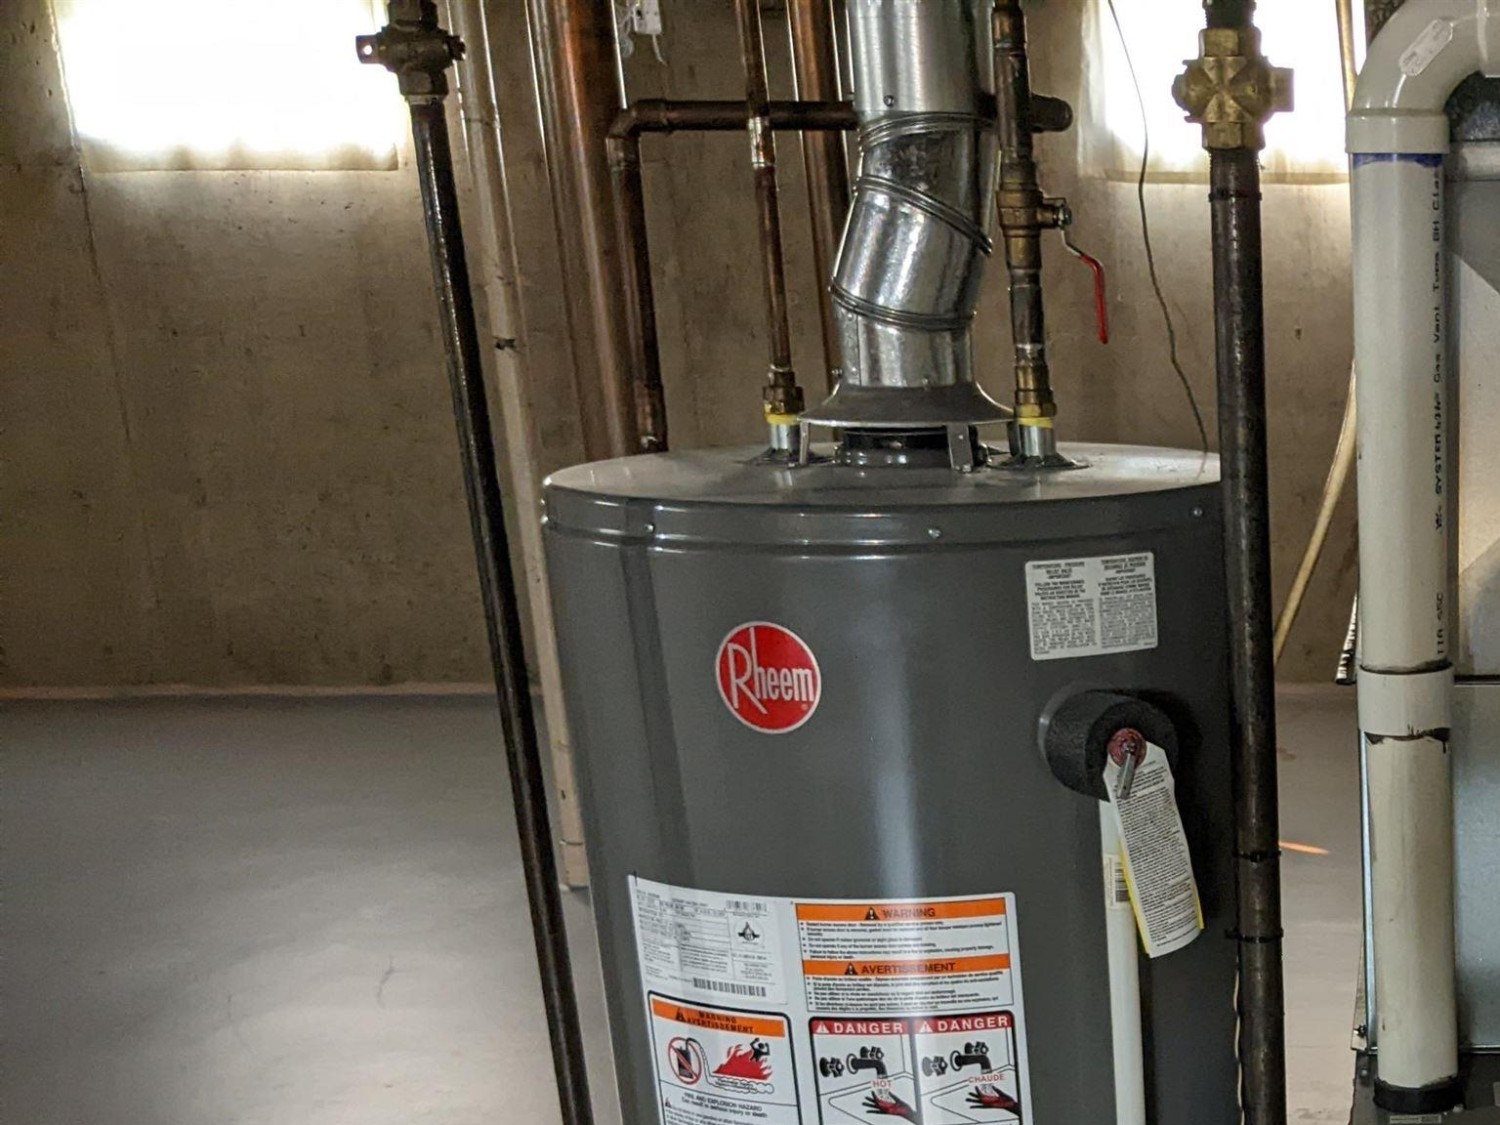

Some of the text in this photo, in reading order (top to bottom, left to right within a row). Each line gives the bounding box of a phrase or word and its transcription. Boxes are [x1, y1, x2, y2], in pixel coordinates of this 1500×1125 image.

[727, 627, 814, 714] Rheem
[883, 907, 936, 918] WARNING
[861, 962, 956, 974] AVERTISSEMENT
[699, 1012, 737, 1024] WARNING
[938, 1016, 1009, 1031] DANGER
[834, 1023, 904, 1034] DANGER
[872, 1080, 892, 1088] HOT
[968, 1073, 1005, 1084] CHAUDE
